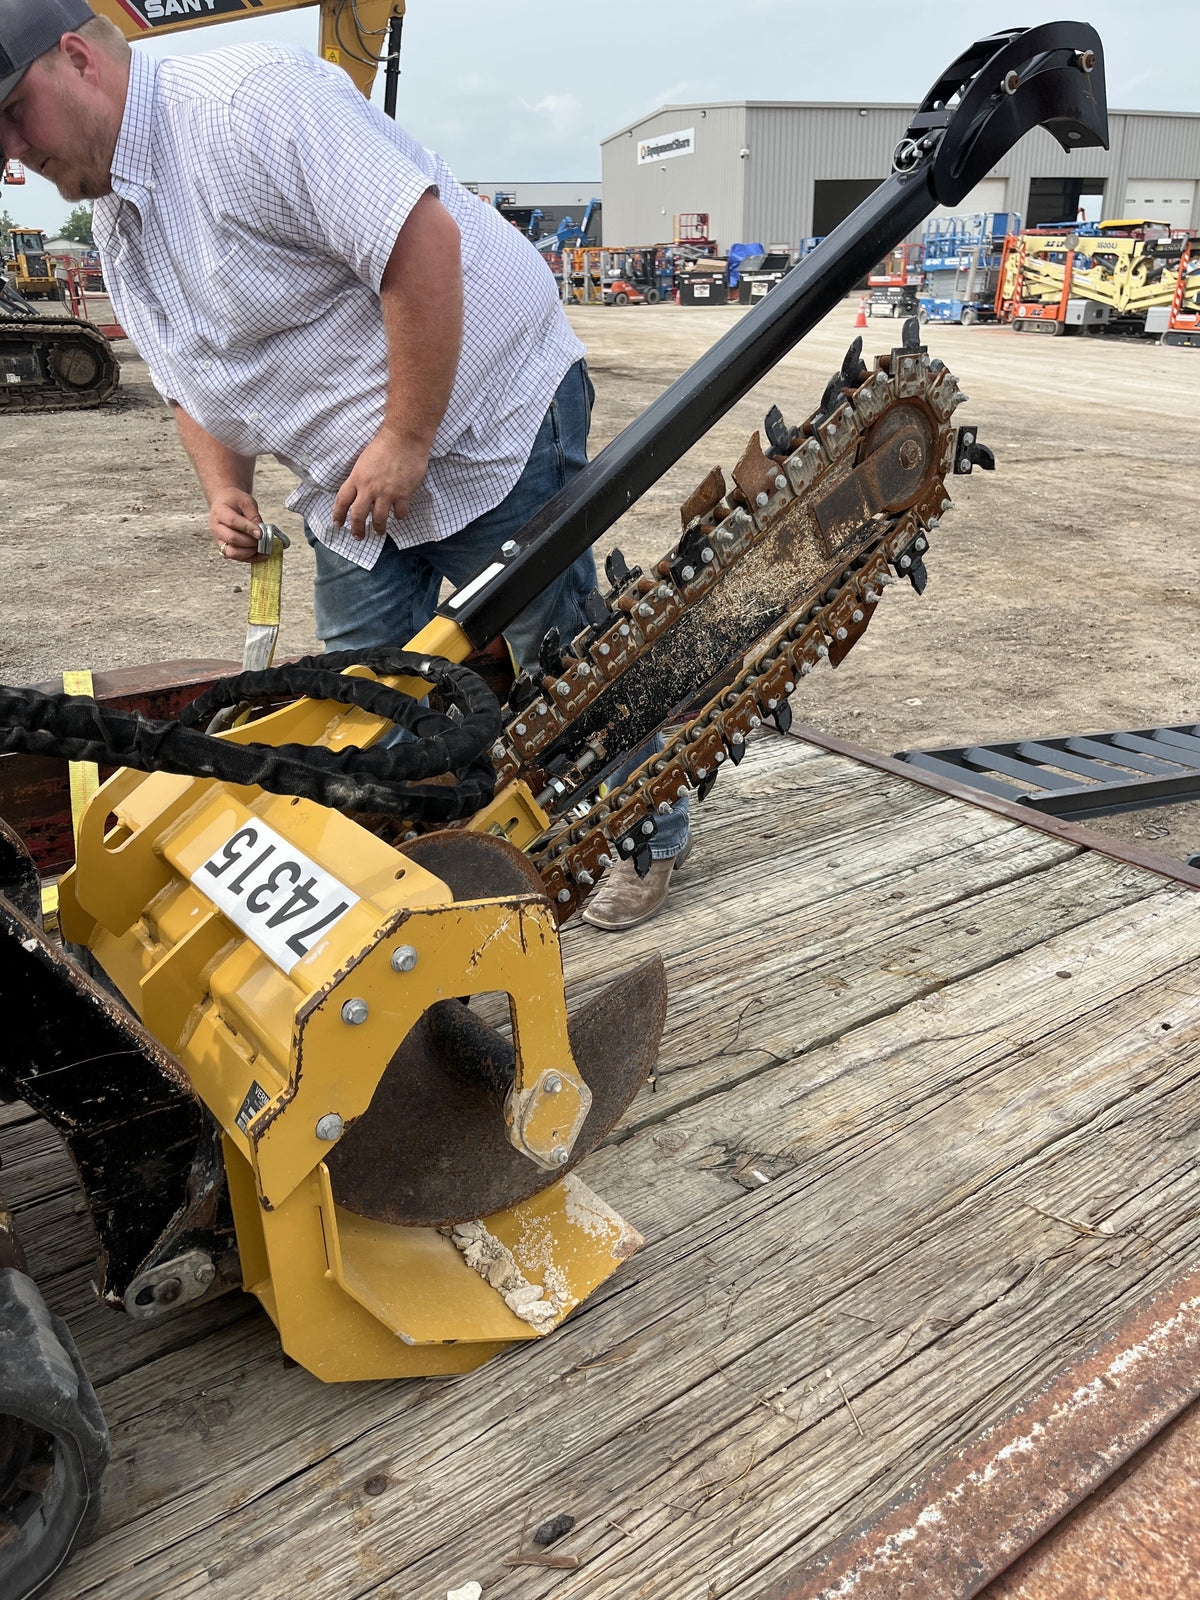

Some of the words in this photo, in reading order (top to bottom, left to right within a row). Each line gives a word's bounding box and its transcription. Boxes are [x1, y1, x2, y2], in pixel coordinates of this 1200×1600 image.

[144, 0, 215, 18] SANY
[646, 138, 690, 158] EquipmentShare
[204, 828, 349, 957] 74315
